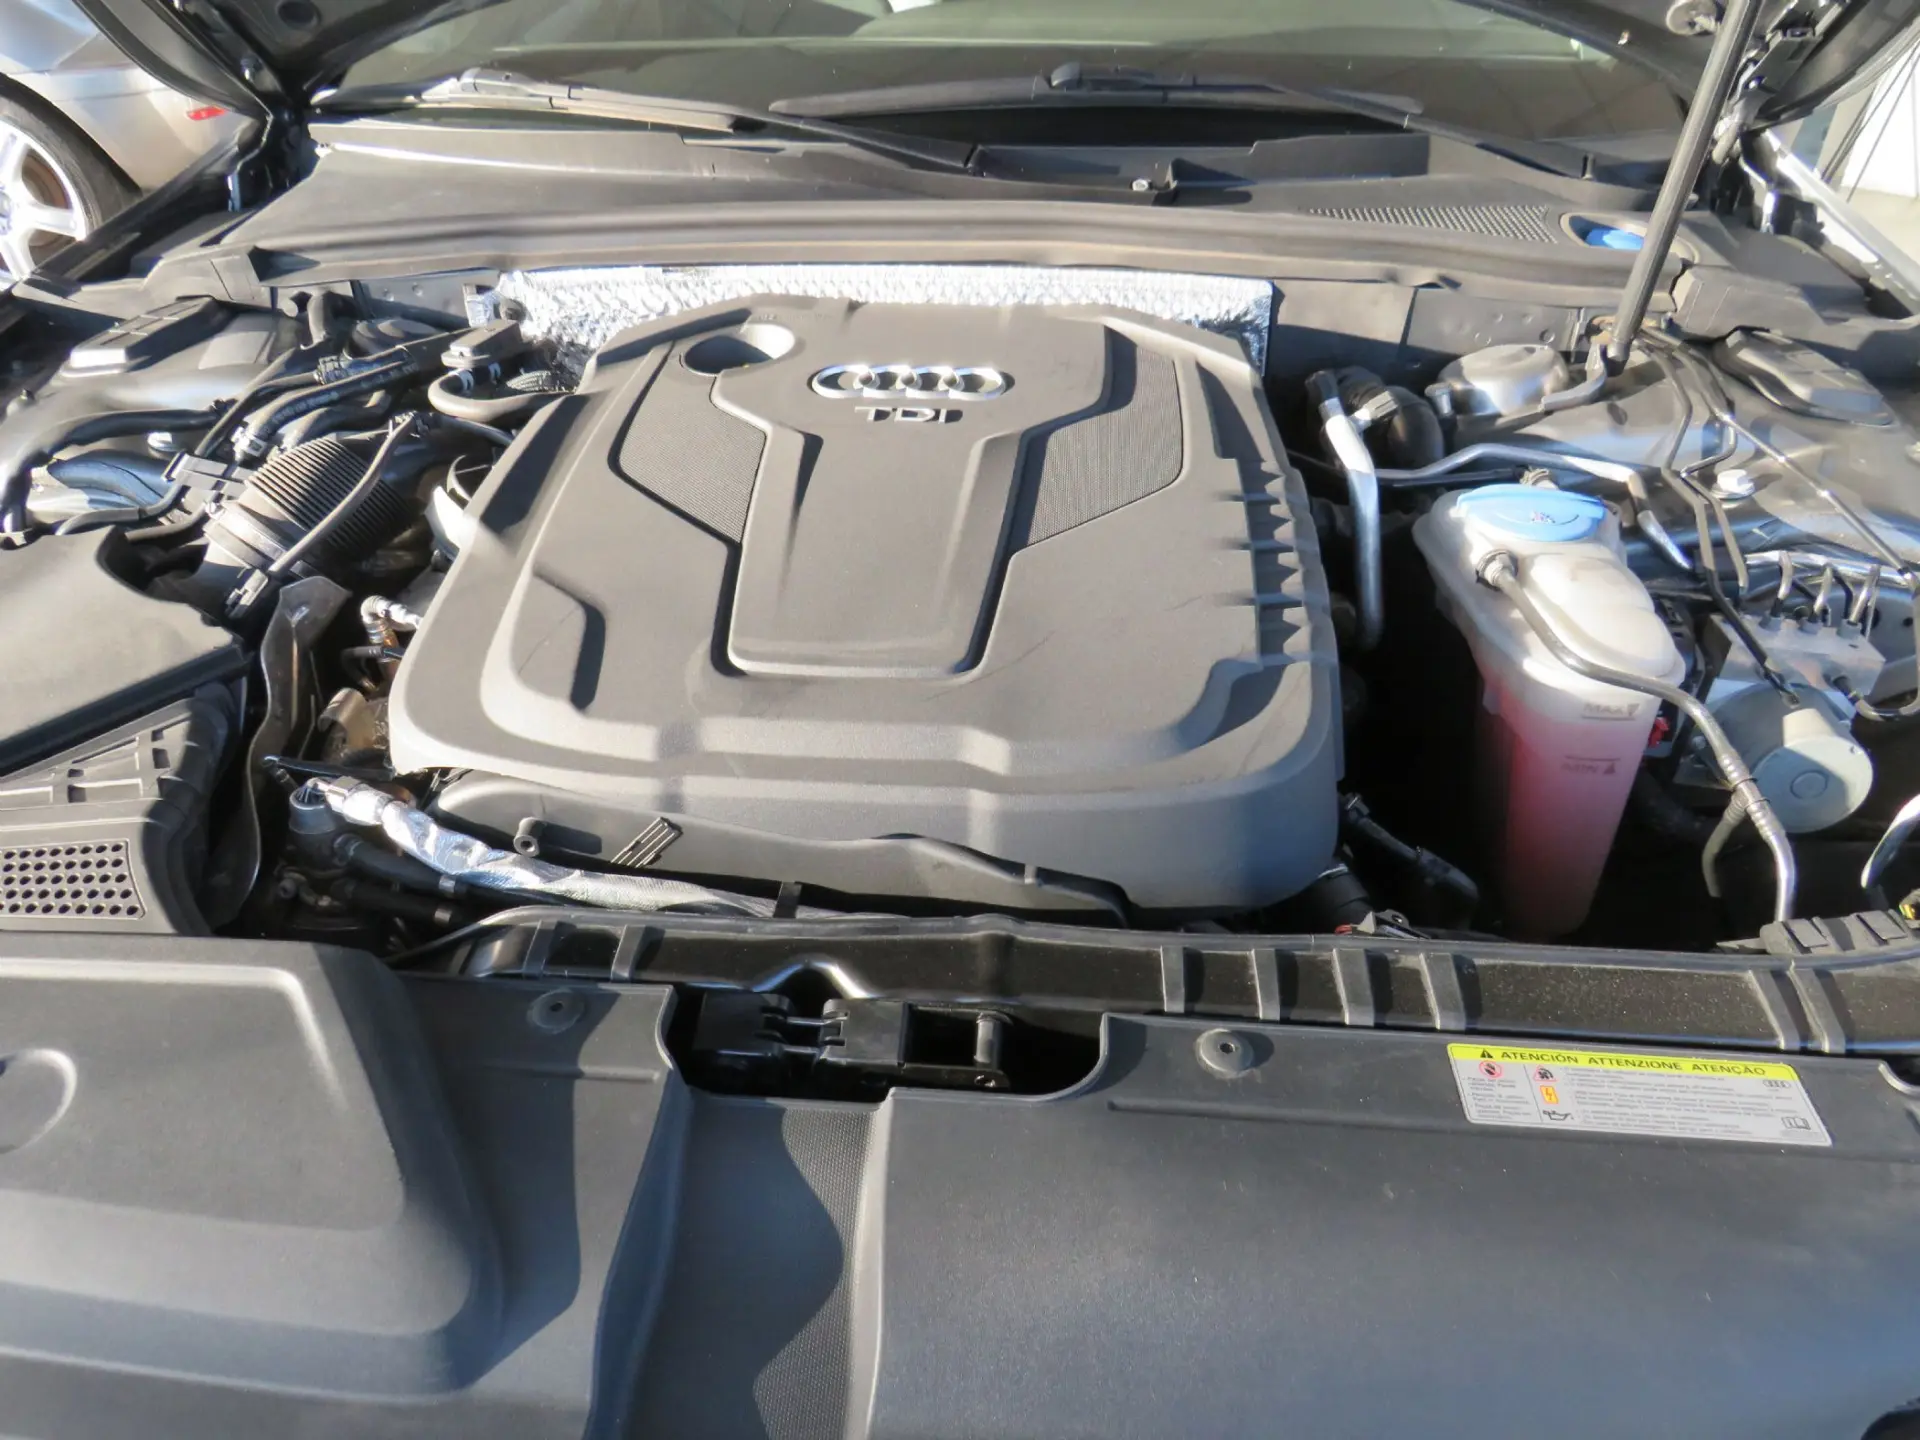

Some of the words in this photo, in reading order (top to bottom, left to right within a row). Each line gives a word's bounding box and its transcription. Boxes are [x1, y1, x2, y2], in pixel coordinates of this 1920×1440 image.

[854, 406, 948, 424] TDI
[1501, 1051, 1578, 1064] ATENCIÓN
[1588, 1056, 1682, 1071] ATTENZIONE
[1692, 1063, 1766, 1077] ATENÇÃO
